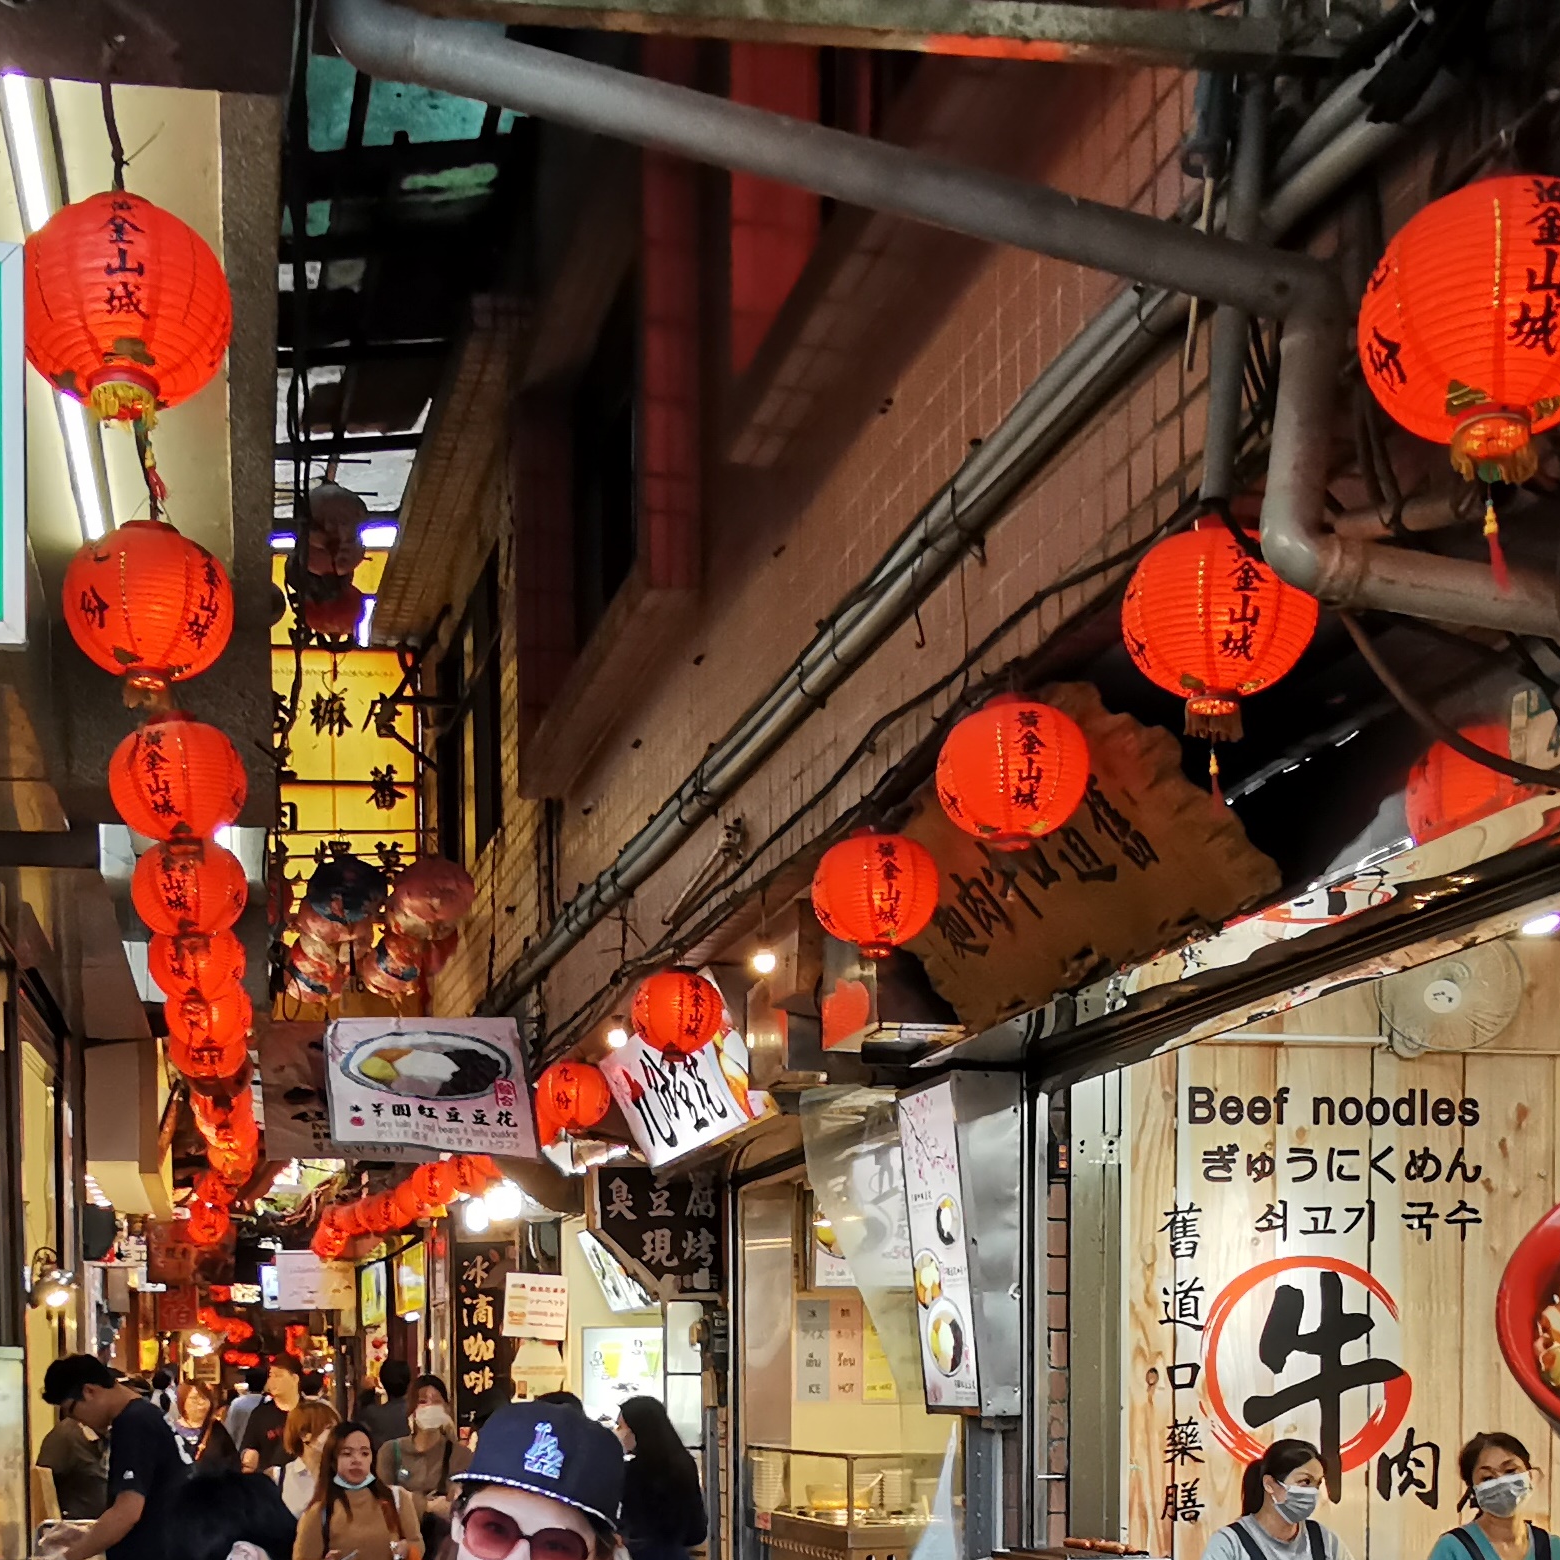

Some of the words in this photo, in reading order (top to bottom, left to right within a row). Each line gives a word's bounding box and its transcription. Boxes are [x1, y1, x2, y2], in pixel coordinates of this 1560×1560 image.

[1186, 1086, 1288, 1126] Beef
[1312, 1087, 1481, 1126] noodles
[1201, 1143, 1484, 1185] ぎゅうにくめん
[1253, 1200, 1377, 1243] 쇠고기
[1399, 1200, 1484, 1242] 국수
[461, 1254, 497, 1397] 冰滴咖啡
[1156, 1202, 1207, 1525] 舊道口藥膳
